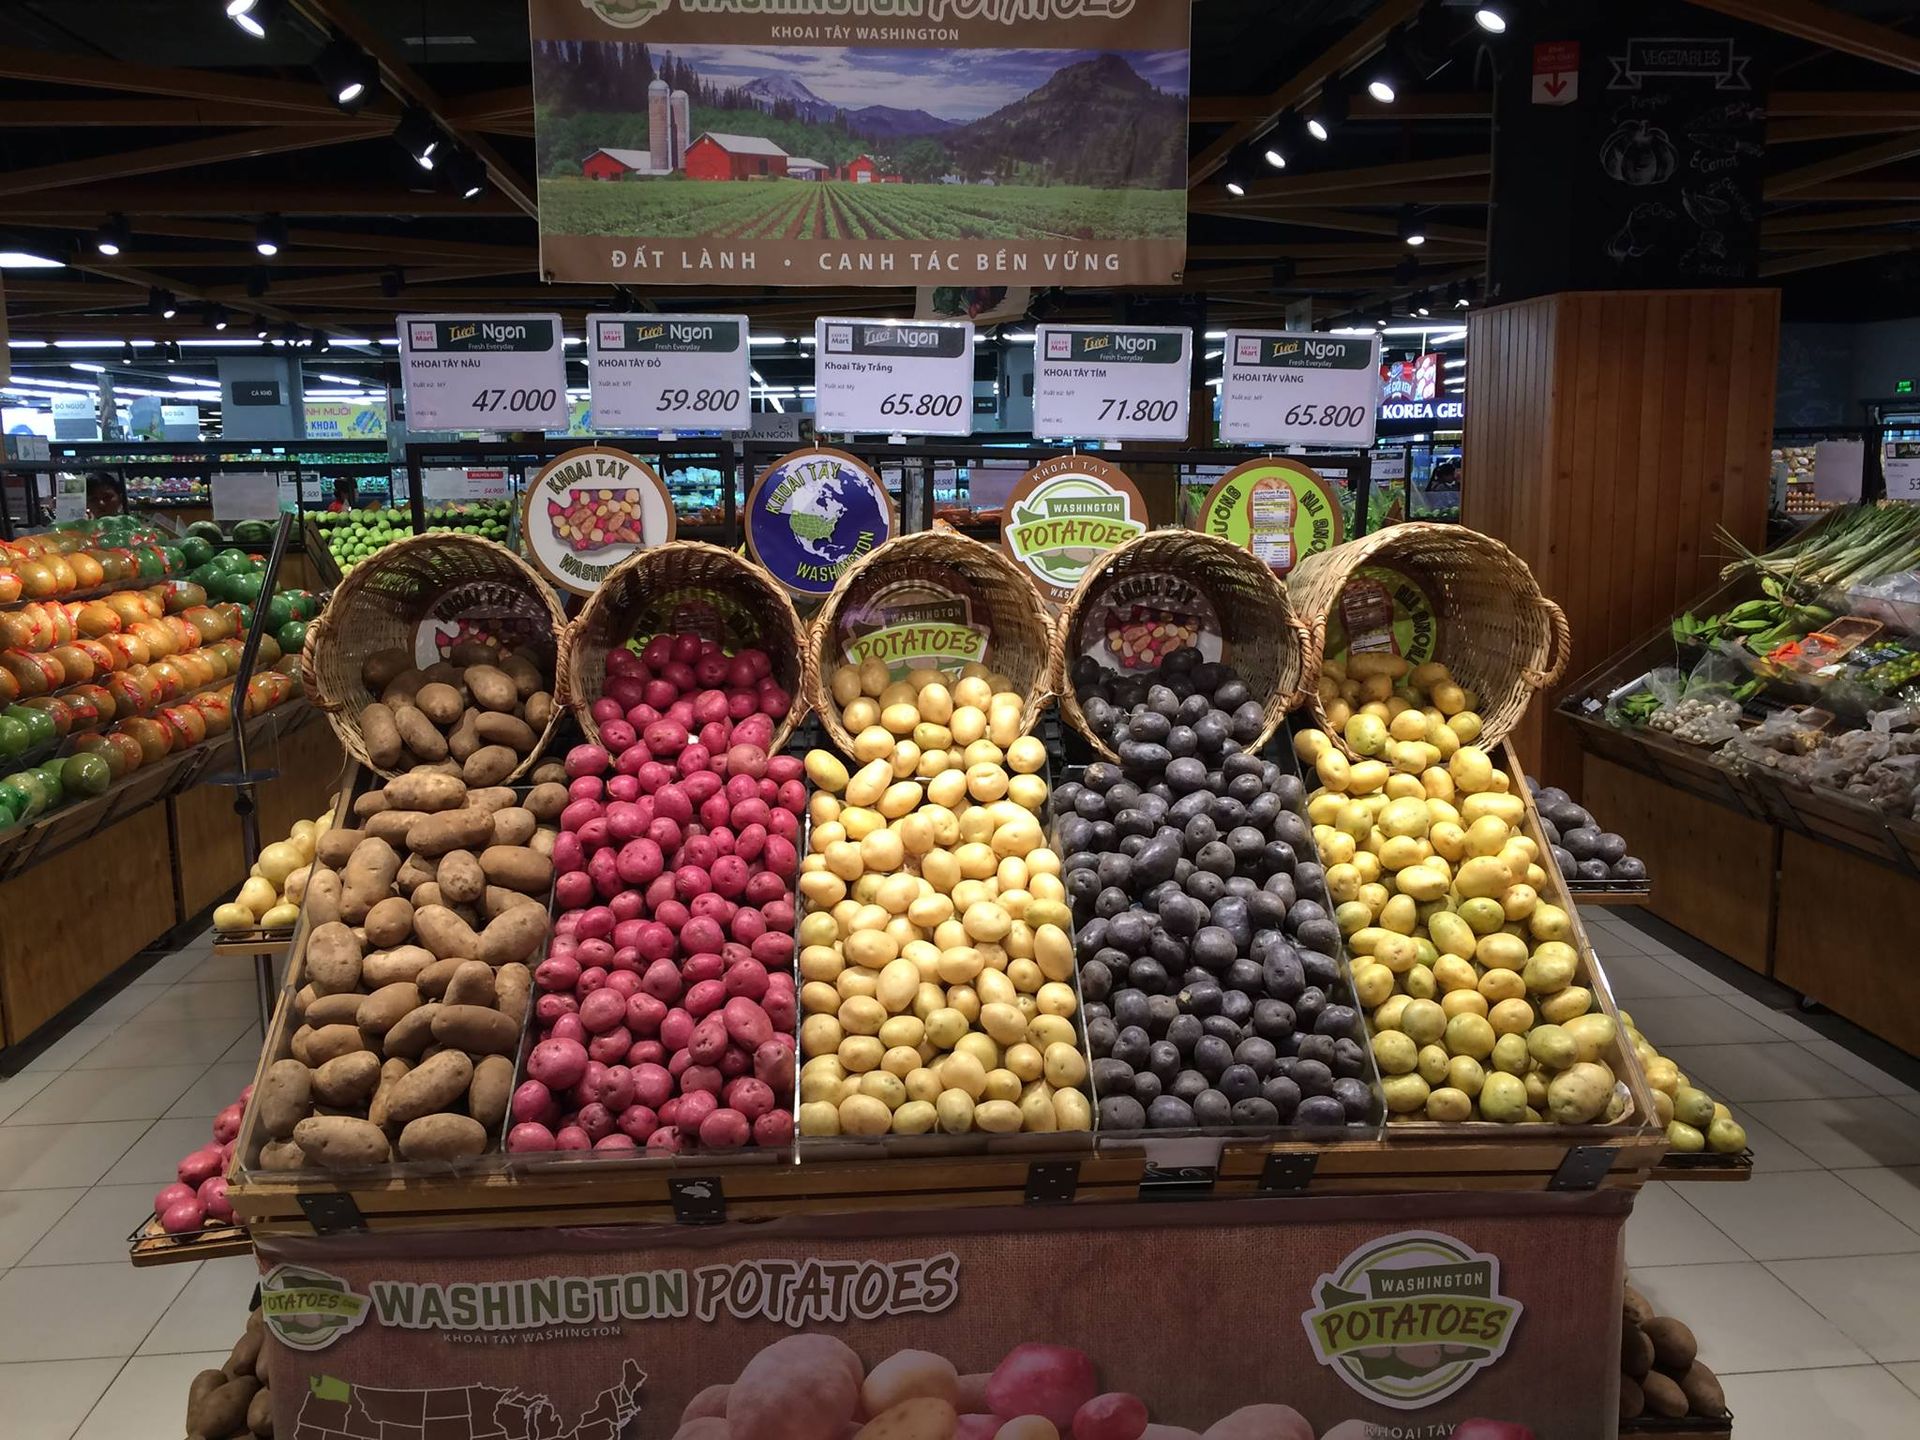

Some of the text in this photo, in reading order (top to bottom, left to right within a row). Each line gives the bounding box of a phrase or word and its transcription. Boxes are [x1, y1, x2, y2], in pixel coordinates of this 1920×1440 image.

[771, 25, 959, 41] KHOAI TÂY WASHINGTON
[1641, 49, 1721, 66] VEGETABLES
[611, 245, 755, 269] ĐẤT LÀNH
[819, 249, 1119, 271] CANH TÁC BỀN VỮNG
[482, 323, 526, 342] Ngon
[603, 334, 621, 342] Mart
[670, 324, 712, 342] Ngon
[897, 328, 939, 347] Ngon
[1115, 335, 1156, 354] Ngon
[1304, 341, 1345, 359] Ngon
[411, 358, 481, 368] KHOAI TÂY NÂU
[598, 359, 627, 368] KHOAI
[630, 358, 644, 368] TÂY
[825, 362, 850, 370] Khoai
[852, 362, 866, 372] Tây
[1044, 368, 1072, 377] KHOAI
[1073, 368, 1089, 377] TÂY
[1232, 373, 1304, 383] KHOAI TÂY VÀNG
[472, 389, 556, 412] 47.000
[656, 389, 740, 412] 59.800
[880, 393, 962, 417] 65.800
[1097, 399, 1178, 422] 71.800
[1285, 405, 1366, 428] 65.800
[1382, 403, 1434, 419] KOREA
[312, 421, 338, 430] KHOAI
[766, 431, 793, 439] NGON
[546, 458, 630, 495] KHOAI TÂY
[1032, 462, 1074, 481] KHOAI
[765, 471, 807, 515] KHOAI
[1053, 503, 1121, 513] WASHINGTON
[1017, 520, 1137, 551] POTATOES
[891, 608, 961, 622] WASHINGTON
[855, 628, 980, 661] POTATOES
[372, 1254, 958, 1328] WASHINGTON POTATOES
[1381, 1272, 1483, 1292] WASHINGTON
[443, 1333, 488, 1344] KHOAI
[522, 1326, 622, 1343] WASHINGTON
[1320, 1303, 1507, 1348] POTATOES
[1364, 1425, 1422, 1440] KHOAI
